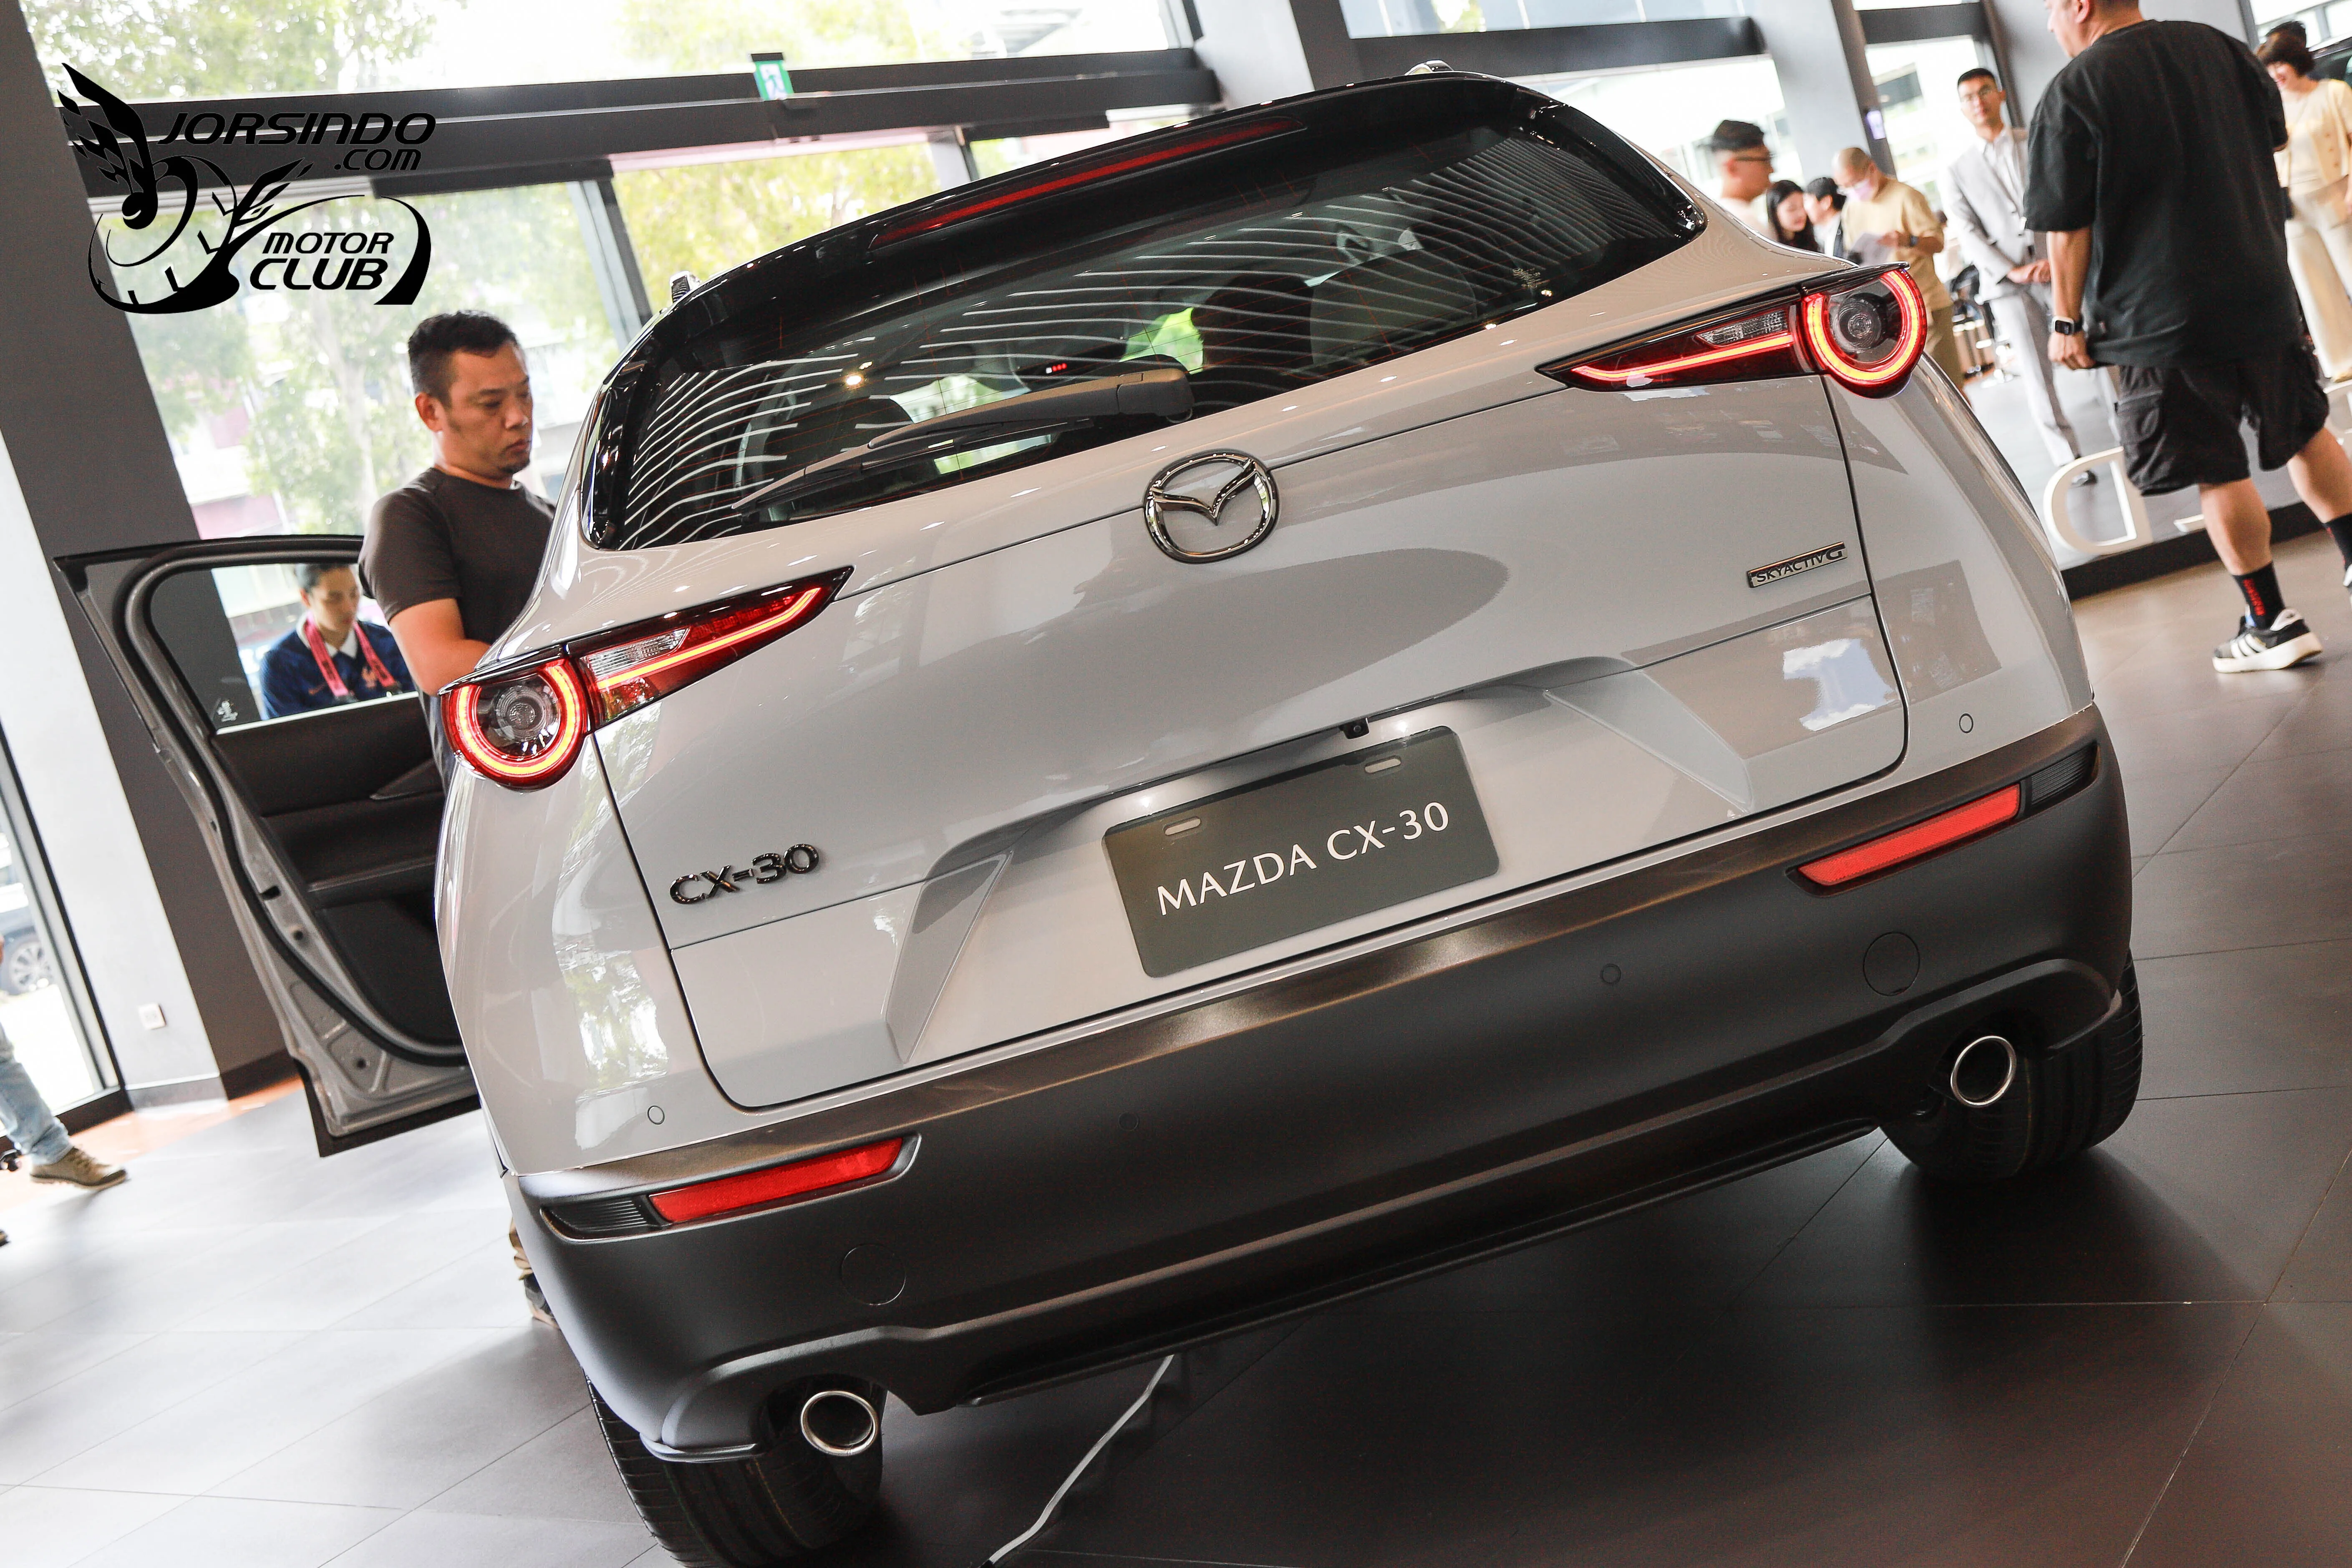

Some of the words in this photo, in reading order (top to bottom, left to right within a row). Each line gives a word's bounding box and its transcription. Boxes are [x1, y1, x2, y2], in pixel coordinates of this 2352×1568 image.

[669, 843, 820, 905] CX-30
[1157, 843, 1317, 916] MAZDA
[1326, 802, 1450, 860] CX-30
